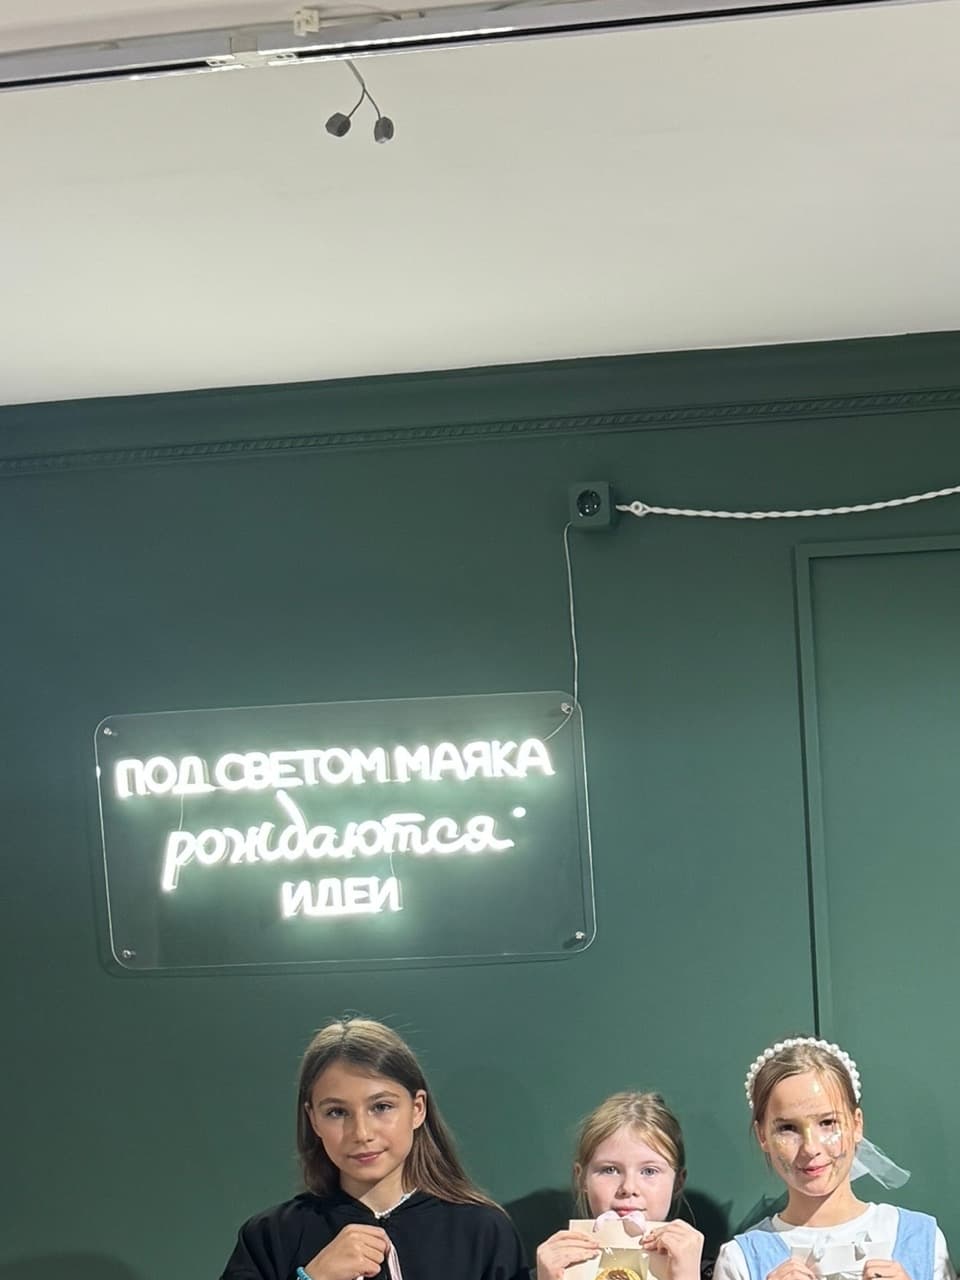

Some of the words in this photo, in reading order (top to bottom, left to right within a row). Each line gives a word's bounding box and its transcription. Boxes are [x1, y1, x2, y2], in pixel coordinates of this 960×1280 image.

[116, 756, 217, 798] ПОД
[215, 747, 390, 791] СВЕТОМ
[394, 738, 556, 783] МАЯКА
[161, 789, 515, 891] рождаются
[281, 876, 403, 918] ИДЕИ
